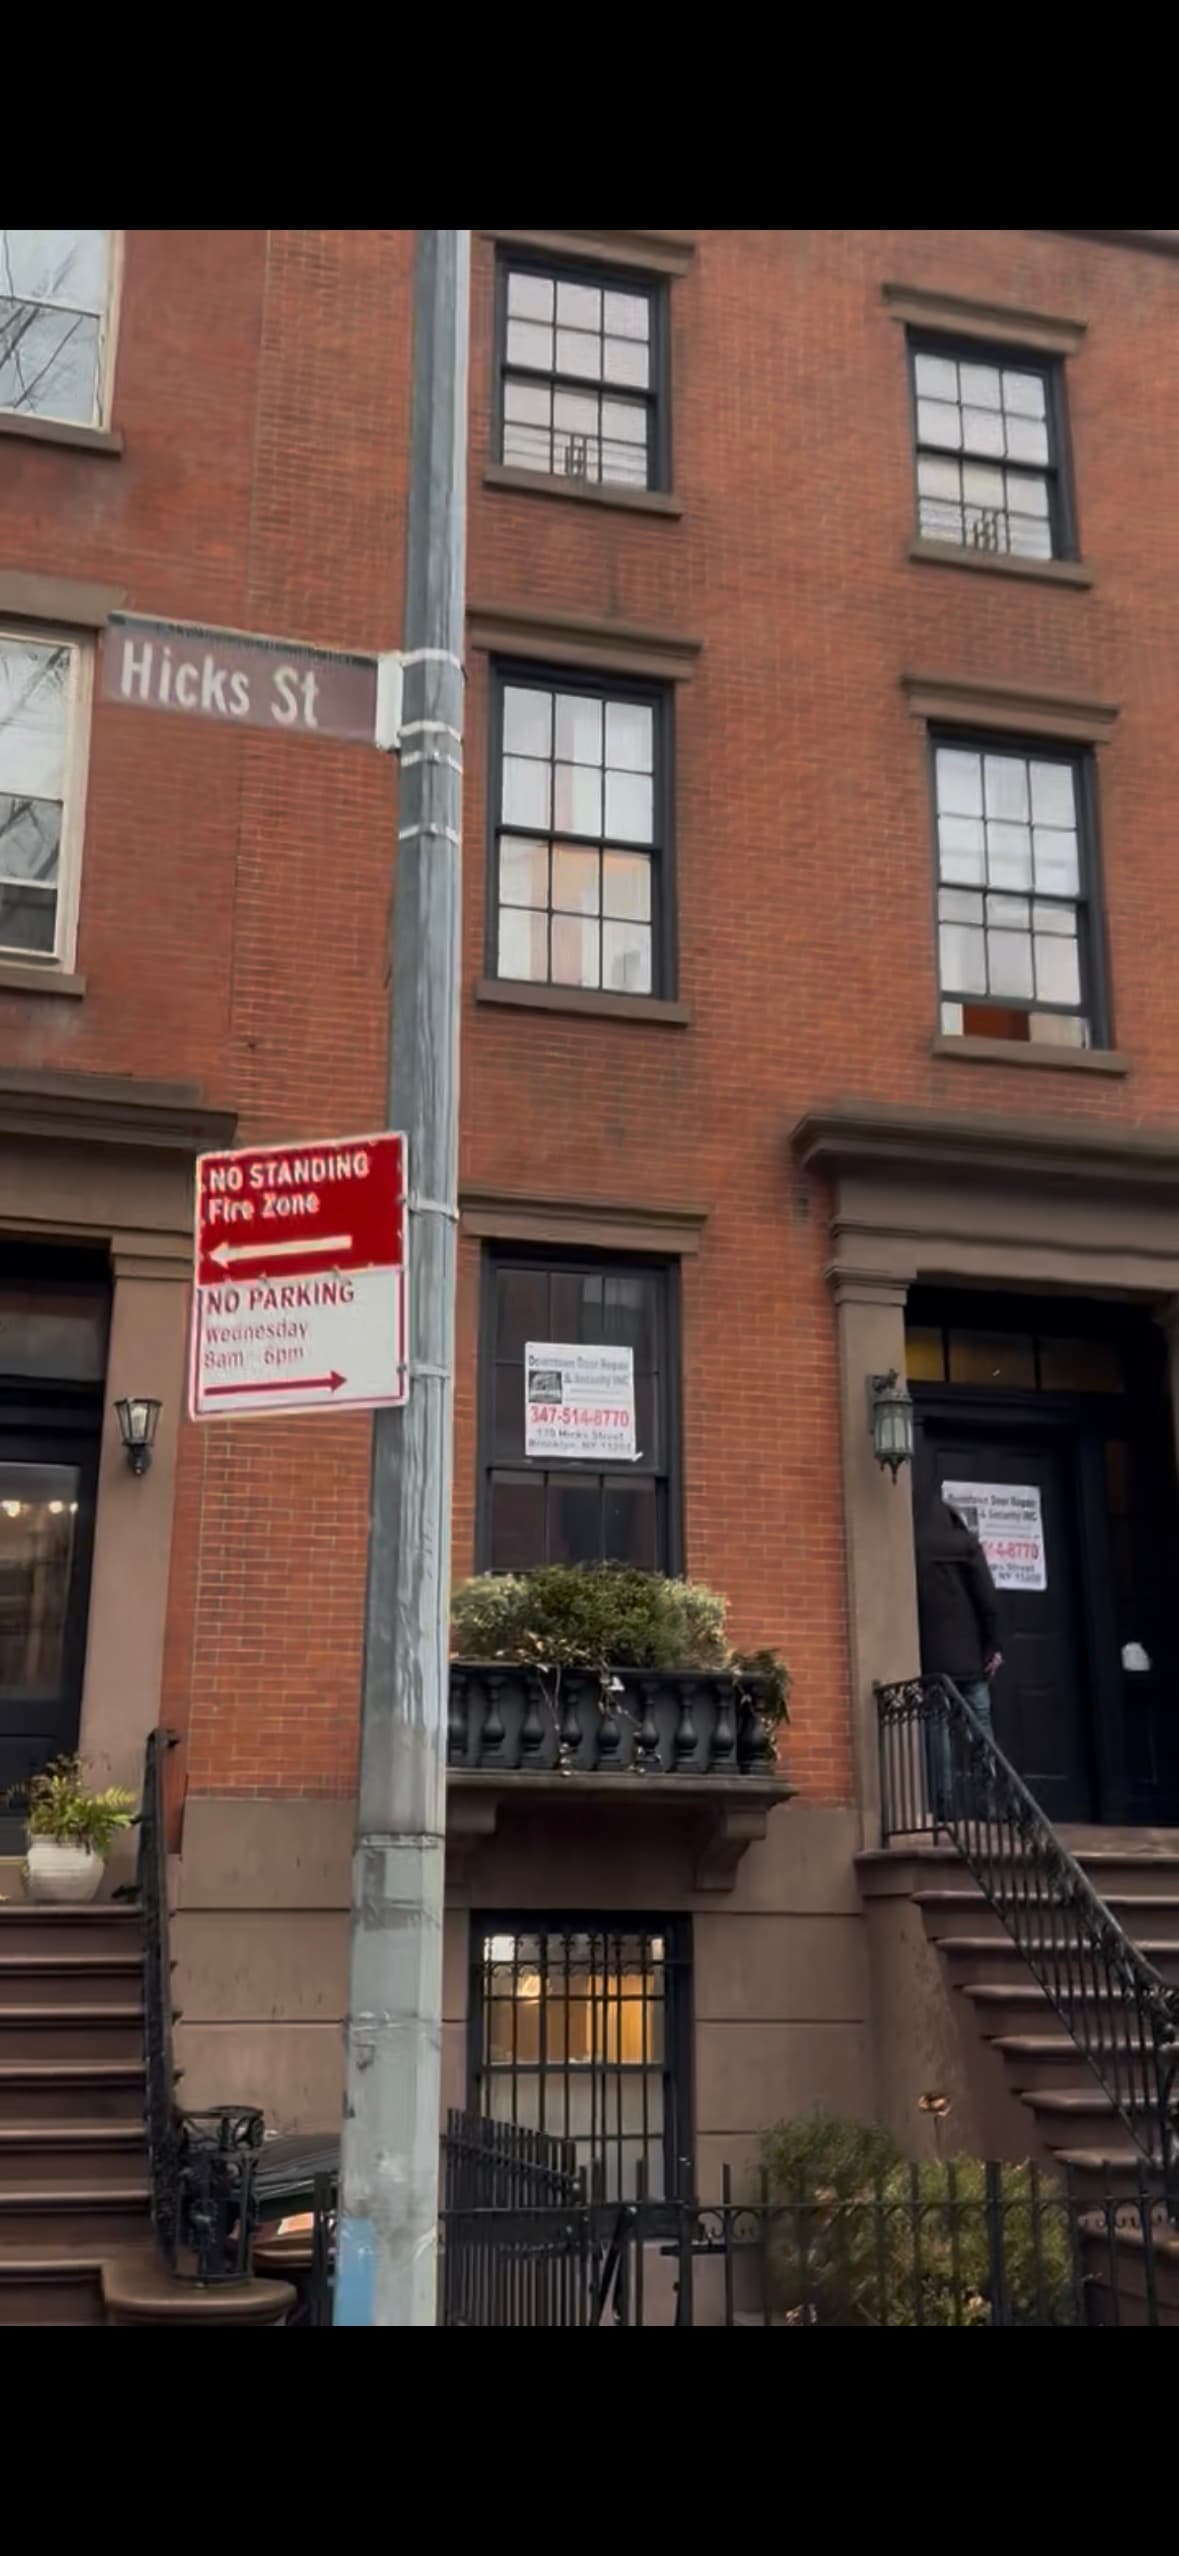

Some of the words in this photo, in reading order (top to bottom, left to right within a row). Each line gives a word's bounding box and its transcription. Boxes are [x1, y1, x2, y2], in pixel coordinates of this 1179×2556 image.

[120, 640, 250, 717] Hicks
[271, 666, 320, 728] St
[209, 1166, 243, 1193] NO
[249, 1151, 370, 1189] STANDING
[208, 1196, 255, 1225] Fire
[261, 1192, 320, 1219] Zone
[207, 1288, 240, 1315] NO
[249, 1280, 355, 1311] PARKING
[206, 1320, 310, 1344] Wednesday
[204, 1351, 244, 1369] 8am
[264, 1346, 304, 1366] 6pm
[531, 1405, 630, 1428] 347-514-8770
